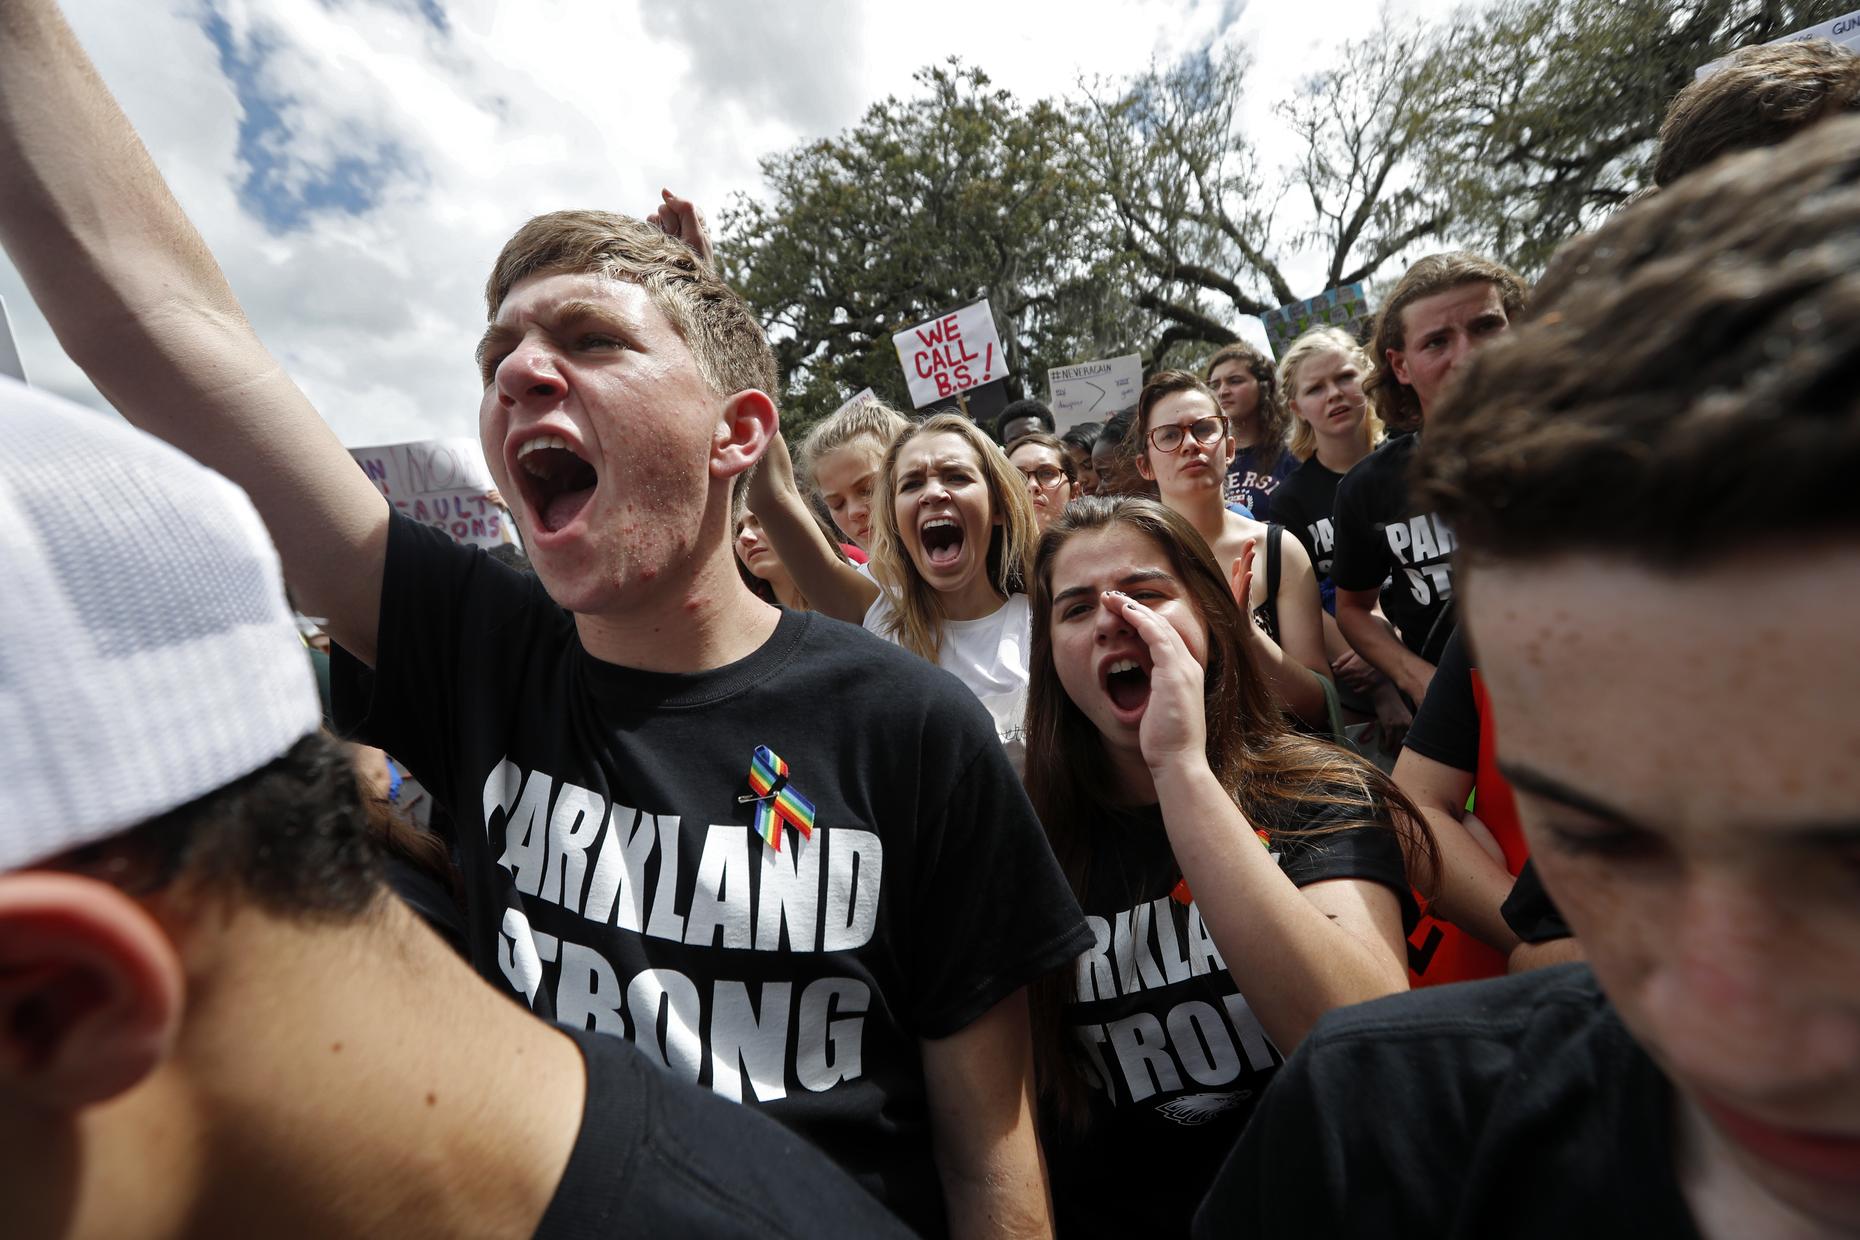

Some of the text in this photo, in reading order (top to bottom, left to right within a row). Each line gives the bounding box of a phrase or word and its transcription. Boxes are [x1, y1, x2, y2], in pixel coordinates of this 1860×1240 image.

[915, 314, 961, 347] WE
[915, 339, 979, 379] CALL
[1051, 363, 1112, 381] #NEVERAGAIN
[1227, 471, 1280, 496] ERSI
[396, 495, 487, 521] AULT
[1385, 511, 1458, 565] PAR
[1401, 563, 1452, 606] ST
[1076, 895, 1229, 1003] RKLA
